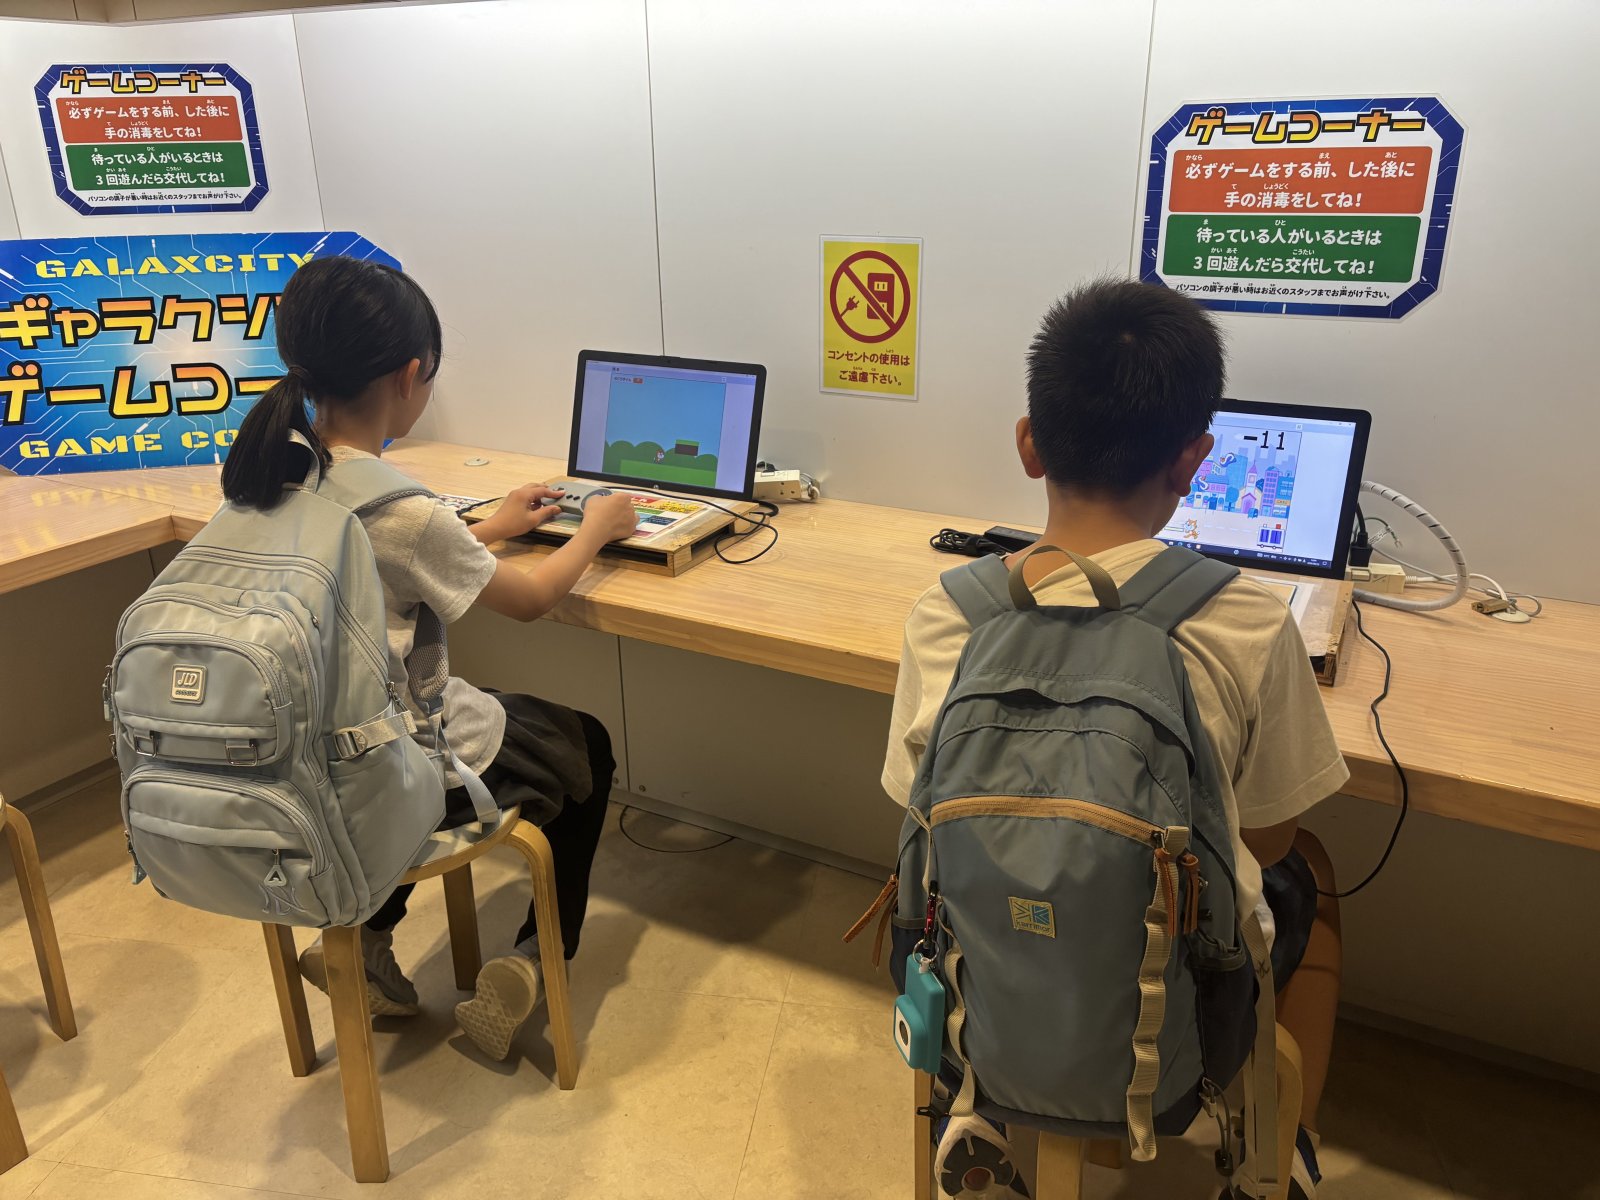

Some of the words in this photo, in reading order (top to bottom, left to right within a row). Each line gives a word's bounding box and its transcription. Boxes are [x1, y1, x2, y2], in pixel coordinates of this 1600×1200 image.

[60, 67, 226, 94] ゲームコーナー
[68, 105, 230, 119] 必ずゲームをする前、した後に
[105, 126, 202, 140] 手の消毒をしてね!
[1185, 108, 1425, 144] ゲームコーナー
[91, 152, 224, 166] 待っている人がいるときは
[1184, 161, 1416, 179] 必ずゲームをする前、した後に
[1223, 191, 1363, 209] 手の消毒をしてね!
[1196, 227, 1383, 246] 待っている人がいるときは
[36, 252, 316, 279] GALAXCITY
[0, 294, 283, 349] ギャラクシ
[828, 350, 911, 366] コンセントの使用は
[839, 370, 902, 386] ご遠慮下さい。
[0, 361, 286, 426] ゲームコー
[19, 433, 163, 459] GAME
[181, 429, 240, 449] CO
[1243, 430, 1286, 451] -11
